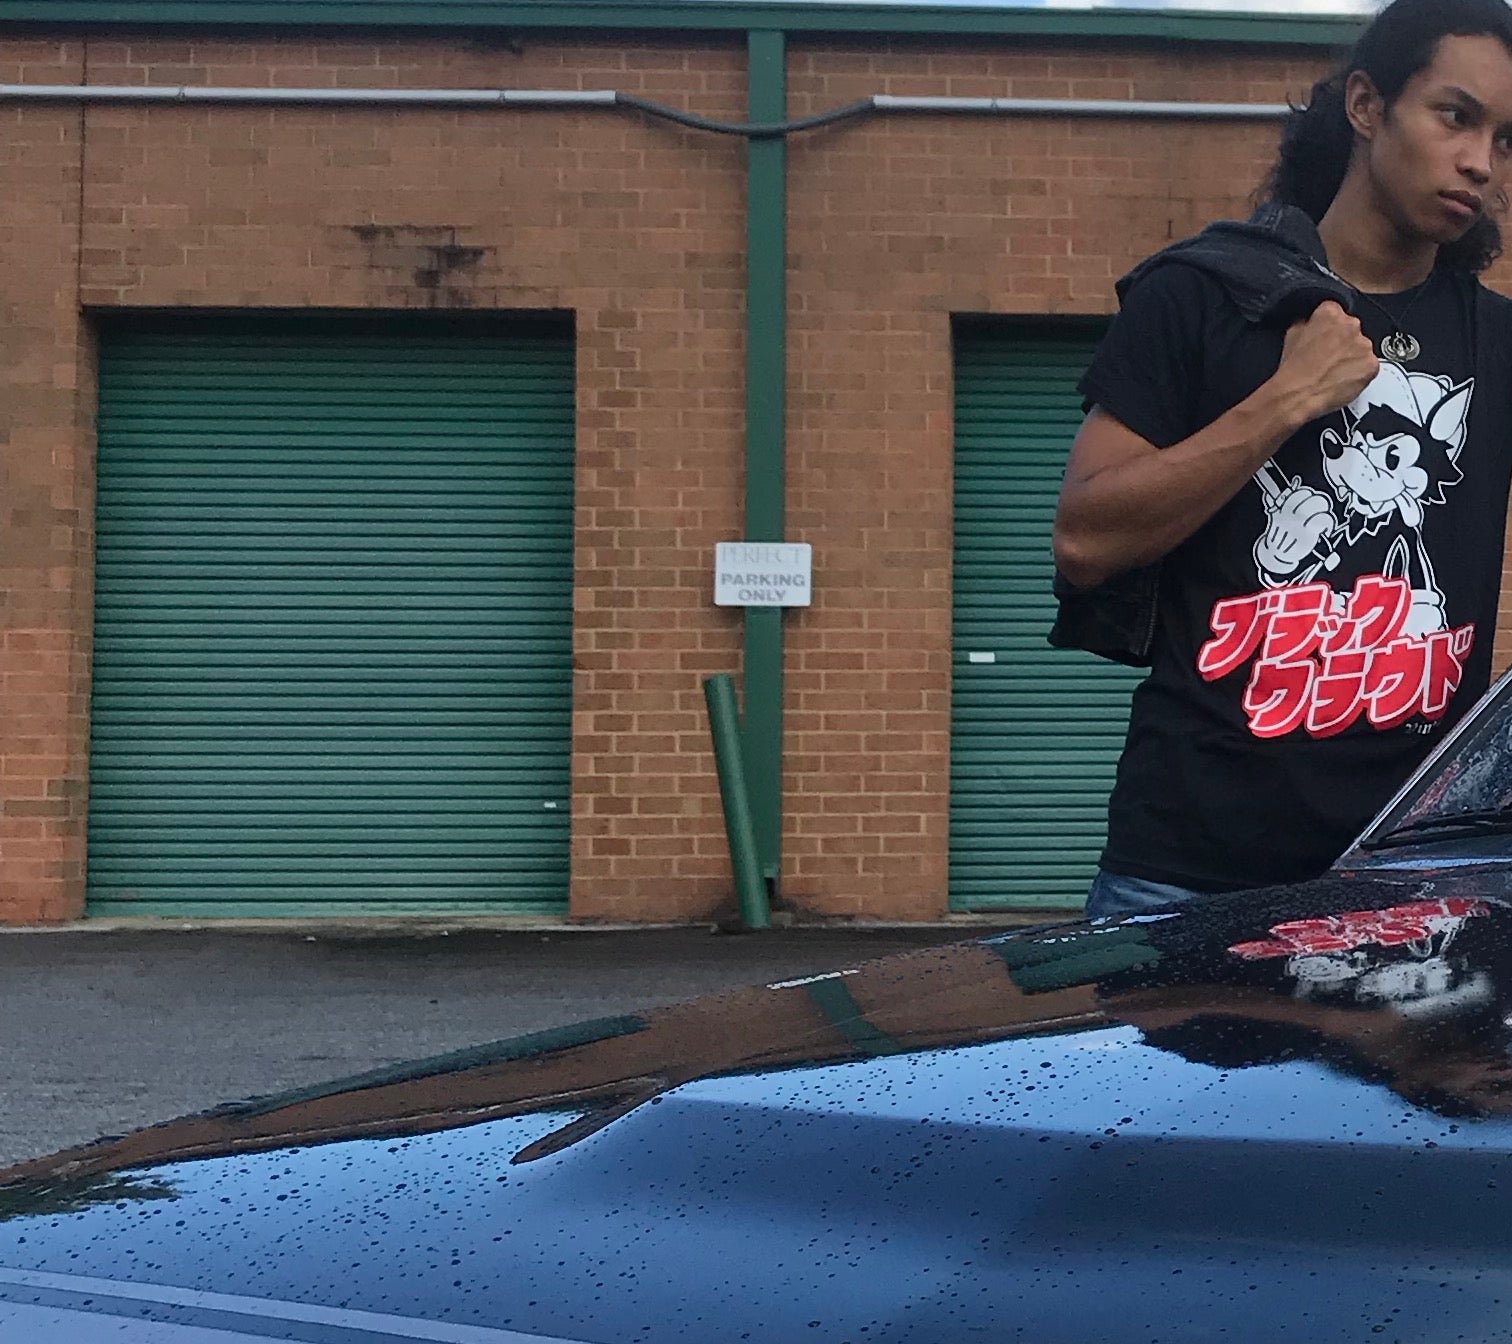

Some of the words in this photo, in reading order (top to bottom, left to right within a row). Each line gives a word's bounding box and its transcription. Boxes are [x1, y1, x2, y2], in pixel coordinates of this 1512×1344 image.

[721, 573, 806, 587] PARKING
[738, 589, 787, 602] ONLY
[1198, 575, 1411, 679] ブラック
[1243, 624, 1475, 737] クラウド
